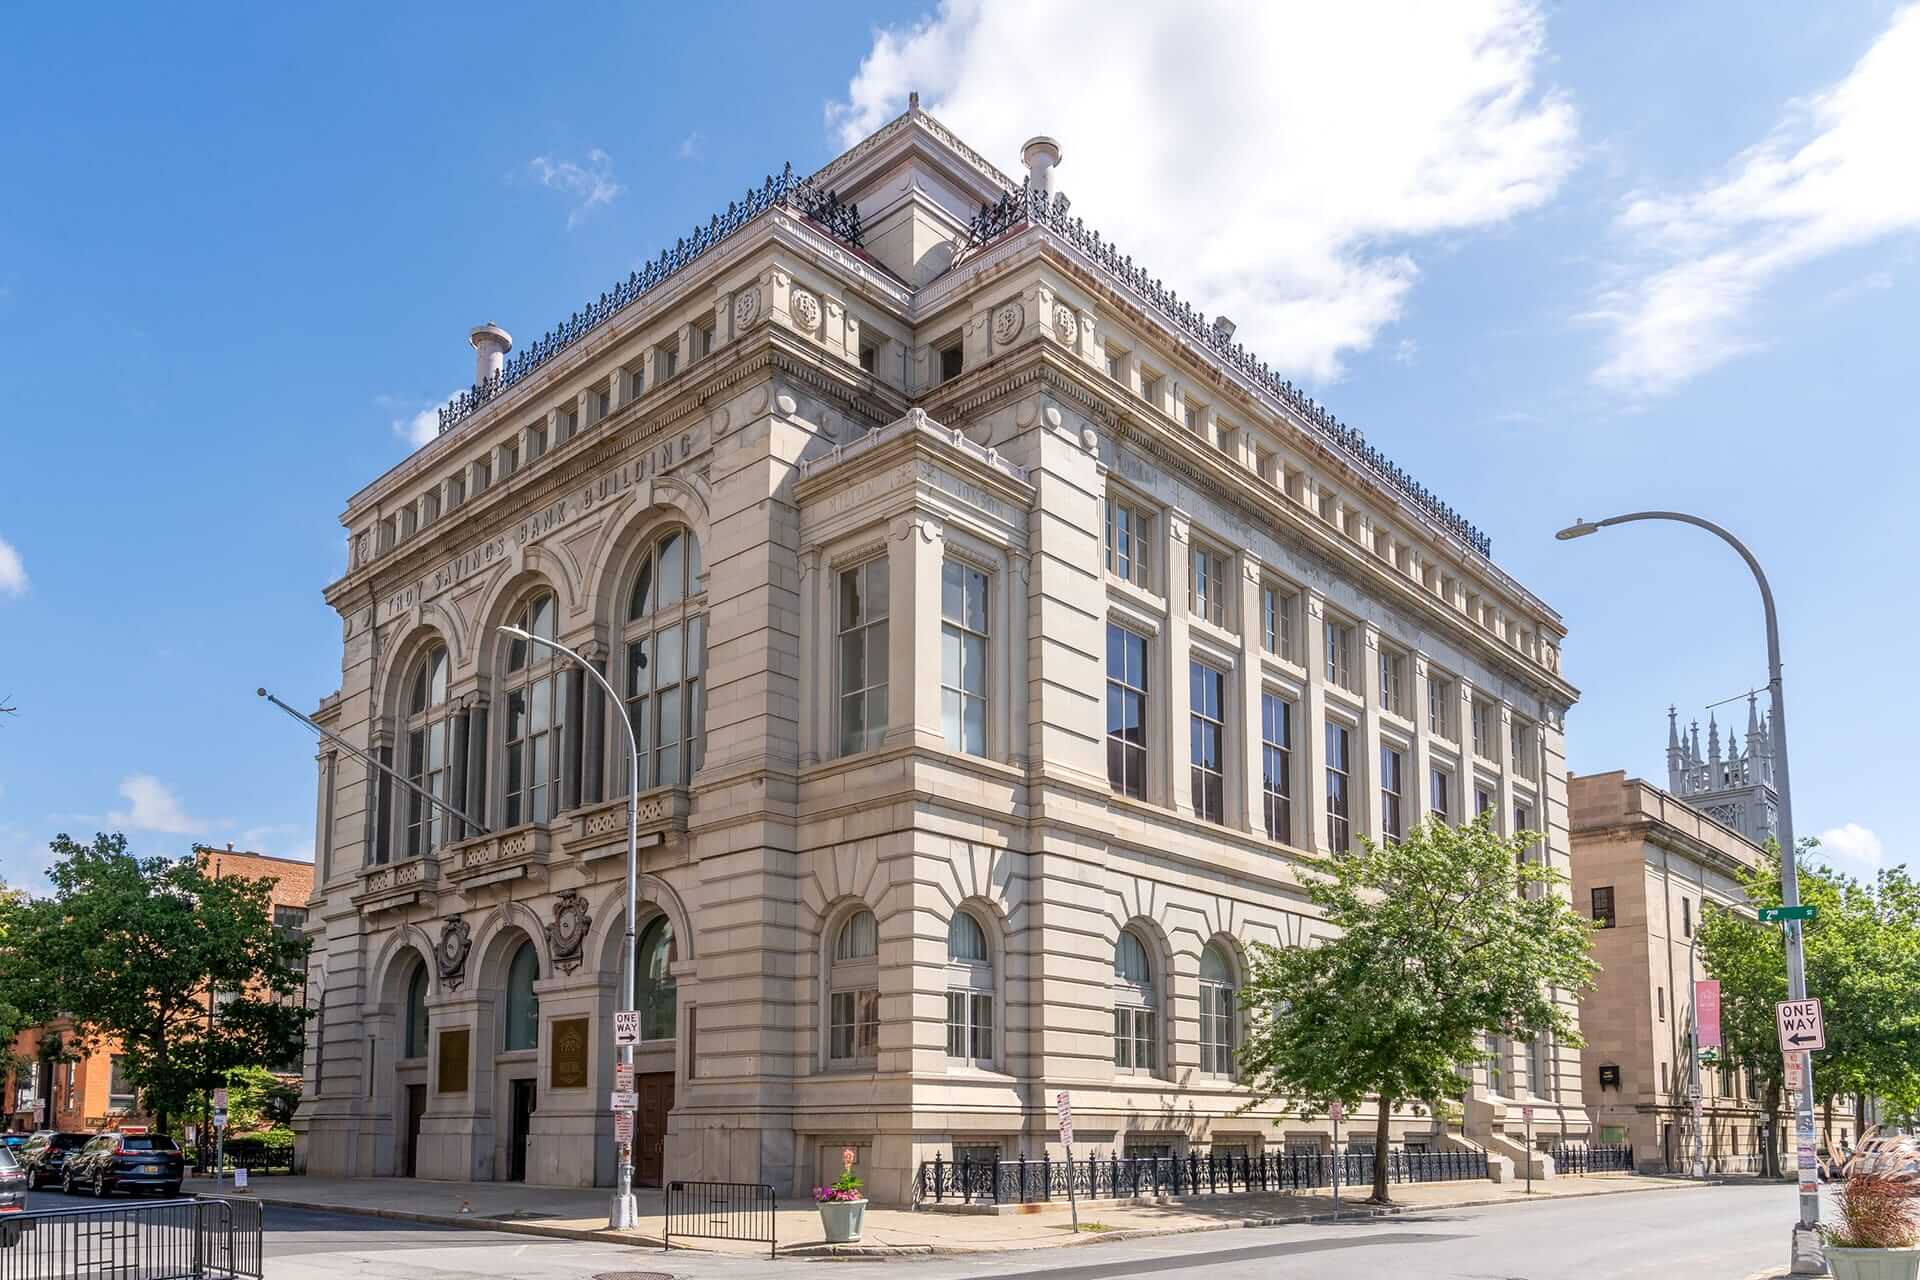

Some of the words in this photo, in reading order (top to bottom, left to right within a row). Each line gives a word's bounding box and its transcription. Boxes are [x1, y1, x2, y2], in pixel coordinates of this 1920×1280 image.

[388, 580, 423, 616] TROY
[433, 535, 505, 591] SAVINGS
[519, 501, 567, 545] BANK
[583, 433, 691, 510] BUILDING
[1783, 1004, 1815, 1017] ONE
[616, 1014, 637, 1023] ONE
[1783, 1017, 1816, 1031] WAY
[616, 1024, 637, 1033] WAY
